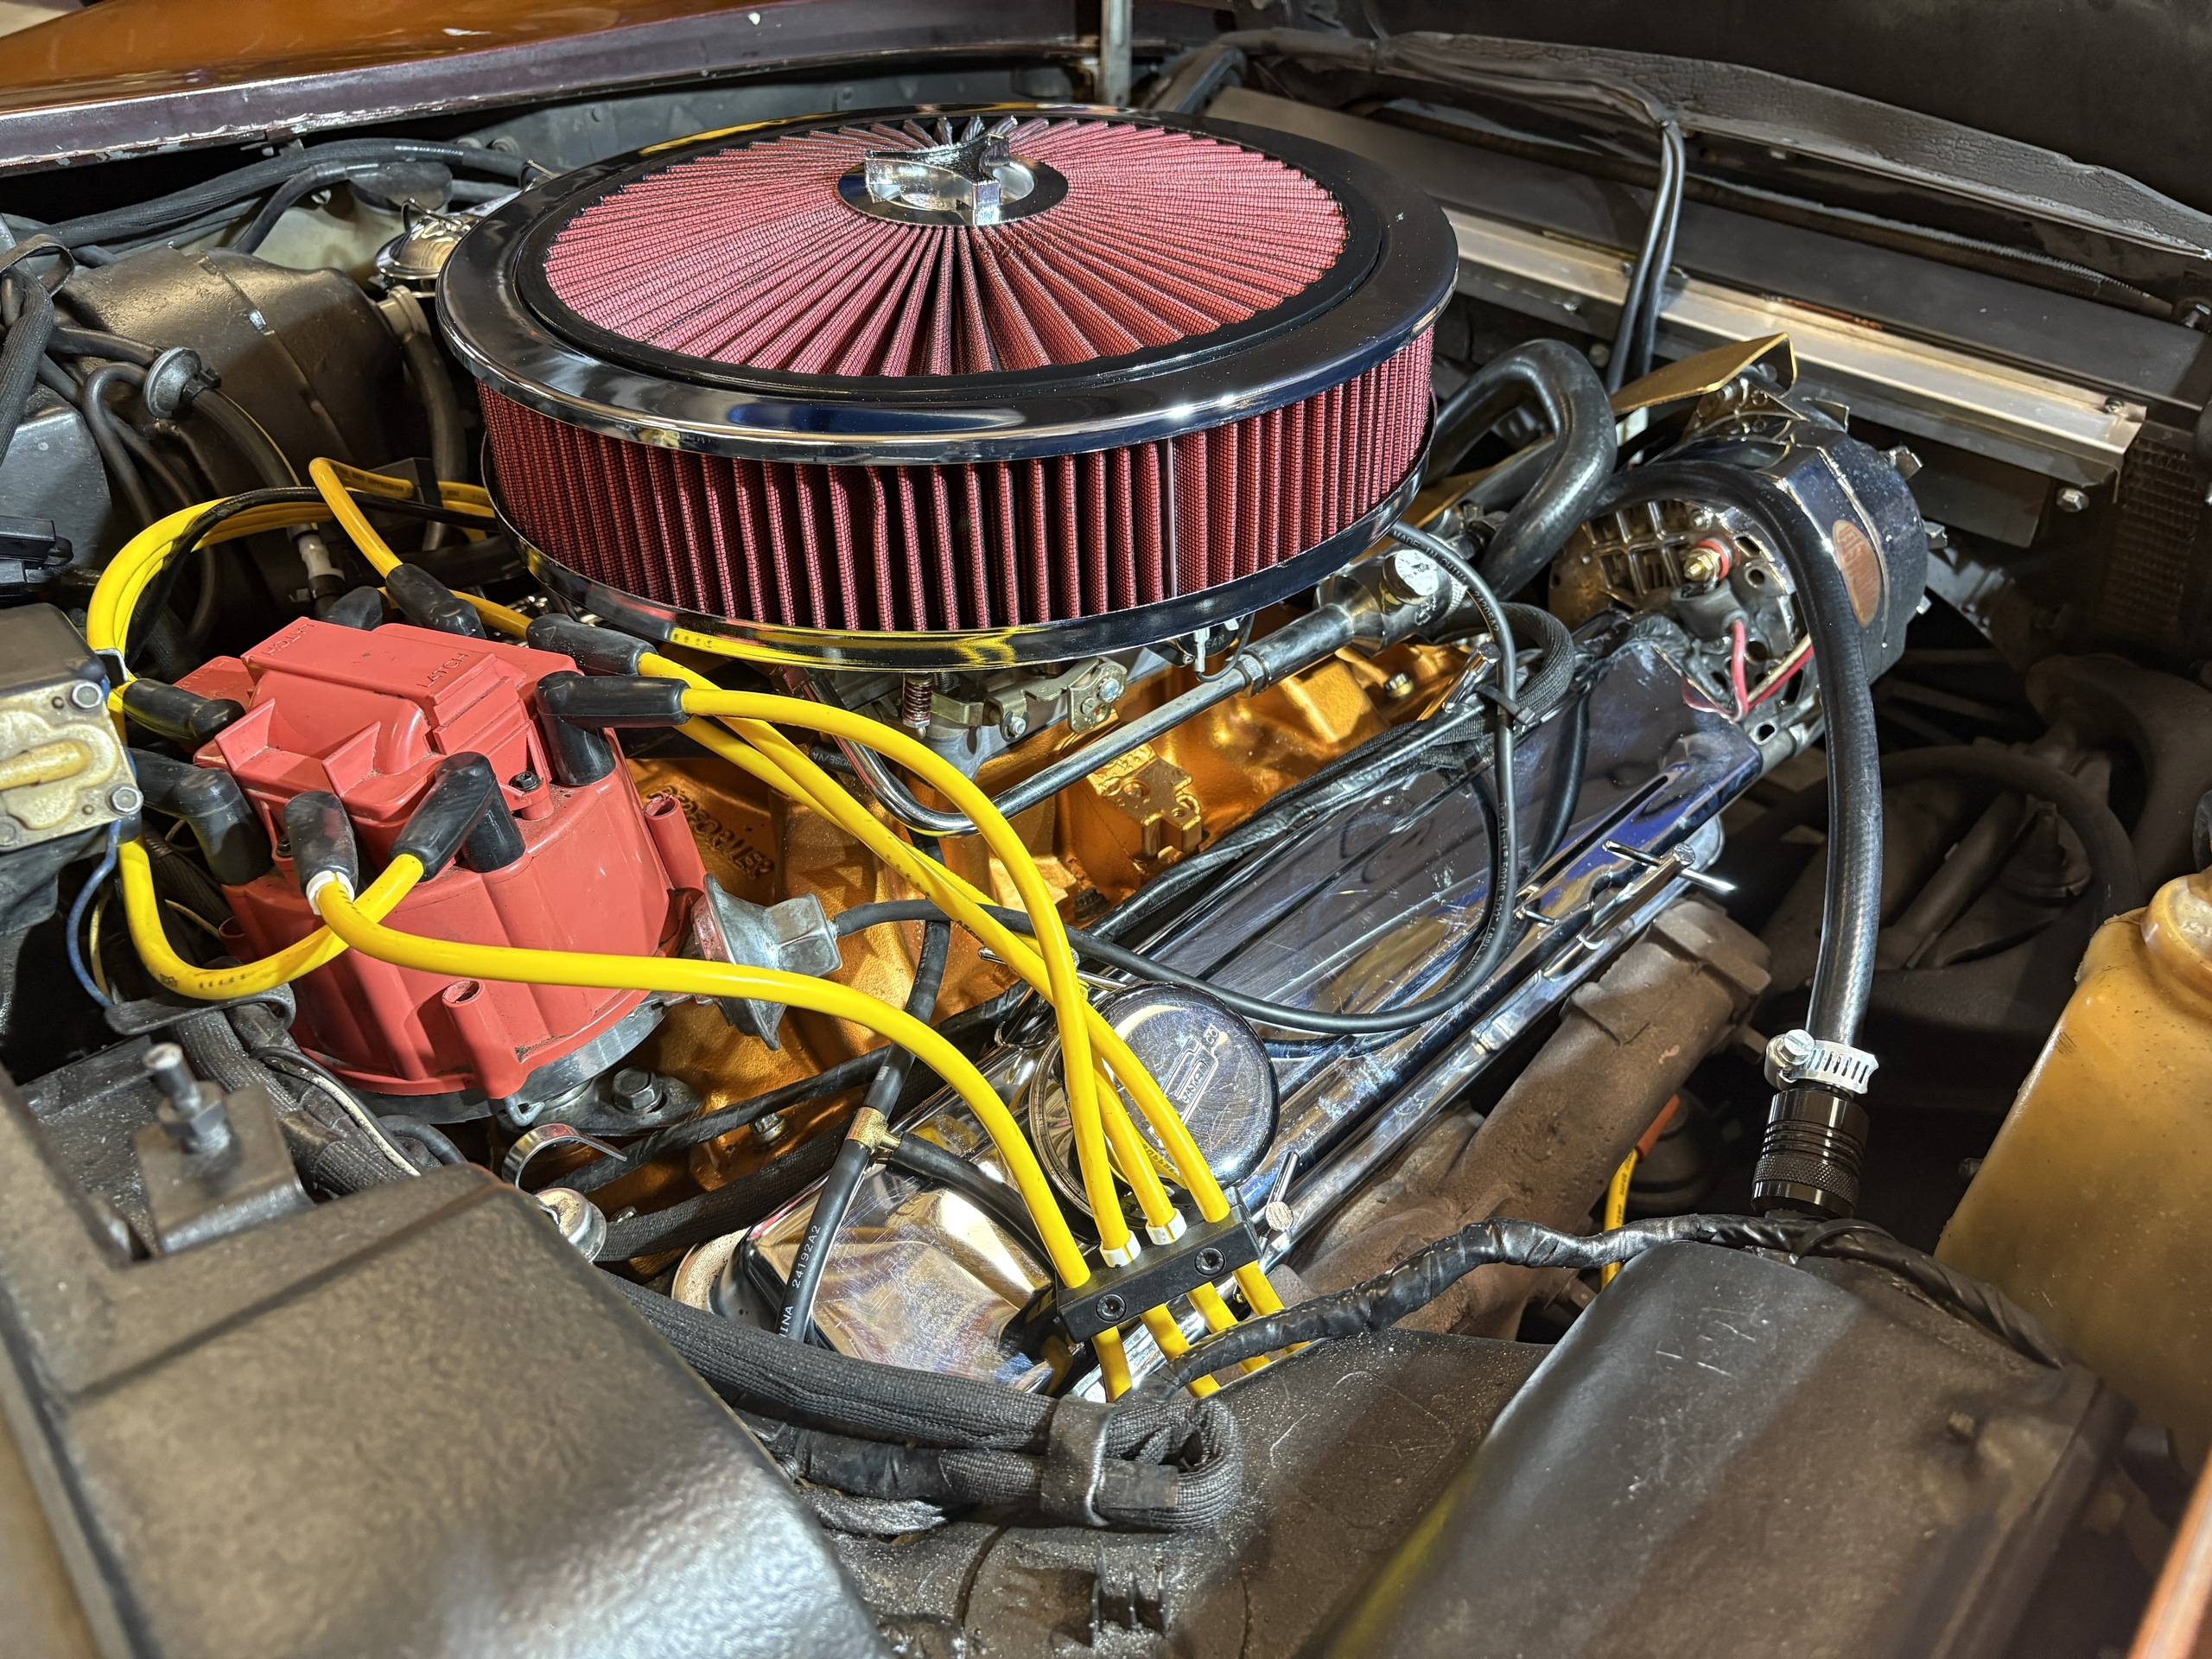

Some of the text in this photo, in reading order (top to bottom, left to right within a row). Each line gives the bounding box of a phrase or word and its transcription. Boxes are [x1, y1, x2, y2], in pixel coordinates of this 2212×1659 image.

[1392, 530, 1421, 547] MADE
[1426, 546, 1438, 558] IN
[1440, 558, 1468, 584] CHINA
[261, 623, 318, 656] LATCH
[416, 652, 470, 689] LATCH
[779, 1225, 821, 1338] INA 24192A2
